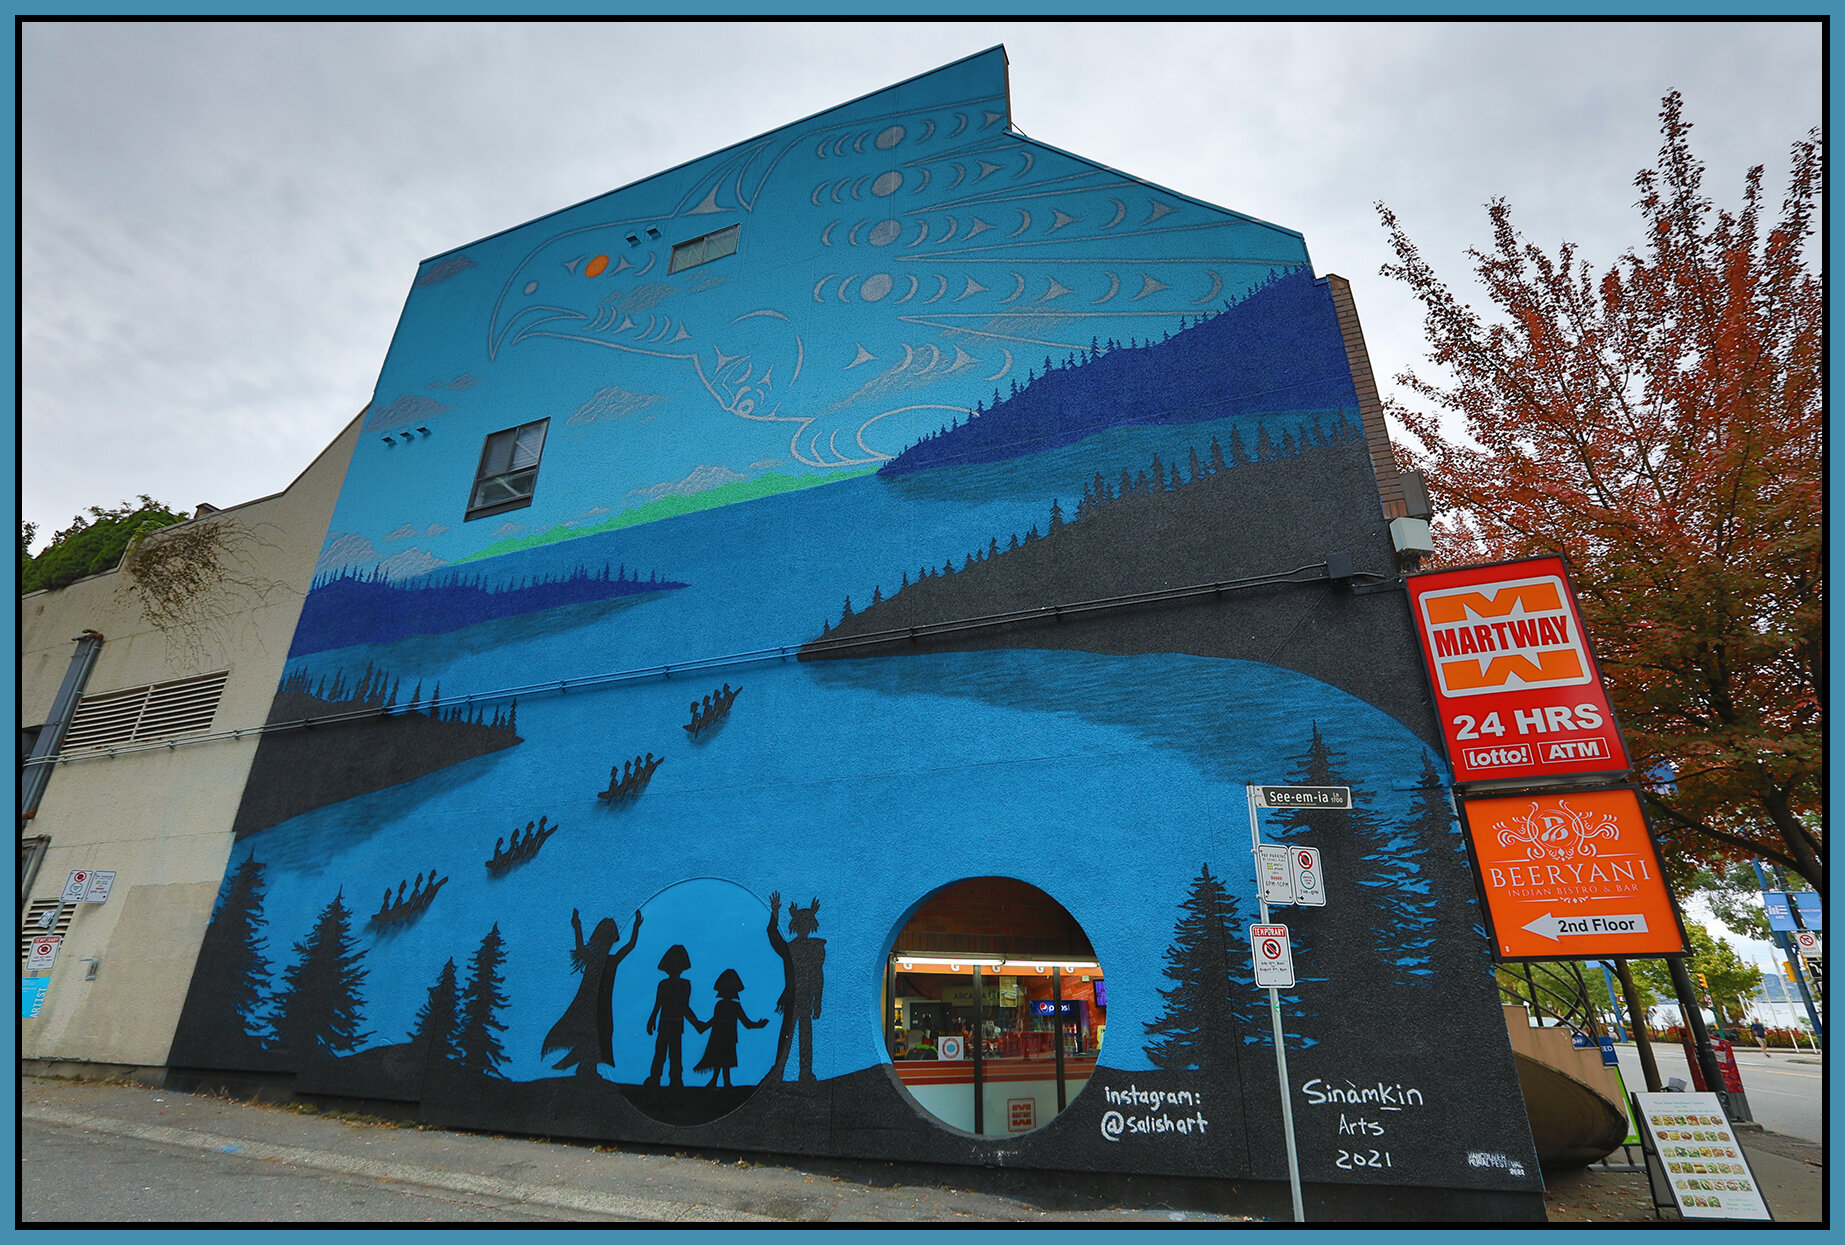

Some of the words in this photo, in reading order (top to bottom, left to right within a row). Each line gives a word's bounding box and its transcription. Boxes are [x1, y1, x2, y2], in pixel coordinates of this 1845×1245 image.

[1433, 615, 1570, 657] MARTWAY
[1453, 712, 1506, 740] 24
[1513, 703, 1604, 735] HRS
[1469, 746, 1528, 767] lotto!
[1549, 741, 1600, 760] ATM
[1269, 791, 1329, 803] See-em-ia
[1489, 860, 1650, 888] BEERYANI
[1508, 887, 1551, 897] INDIAN
[1557, 885, 1598, 895] BISTRO
[1616, 883, 1639, 892] BAR
[1558, 919, 1589, 933] 2nd
[1592, 918, 1635, 932] Floor
[30, 988, 47, 1018] ARTIST
[1104, 1084, 1200, 1112] instagram:
[1100, 1110, 1209, 1141] @salishart
[1339, 1113, 1385, 1136] Arts
[1336, 1150, 1392, 1169] 2021
